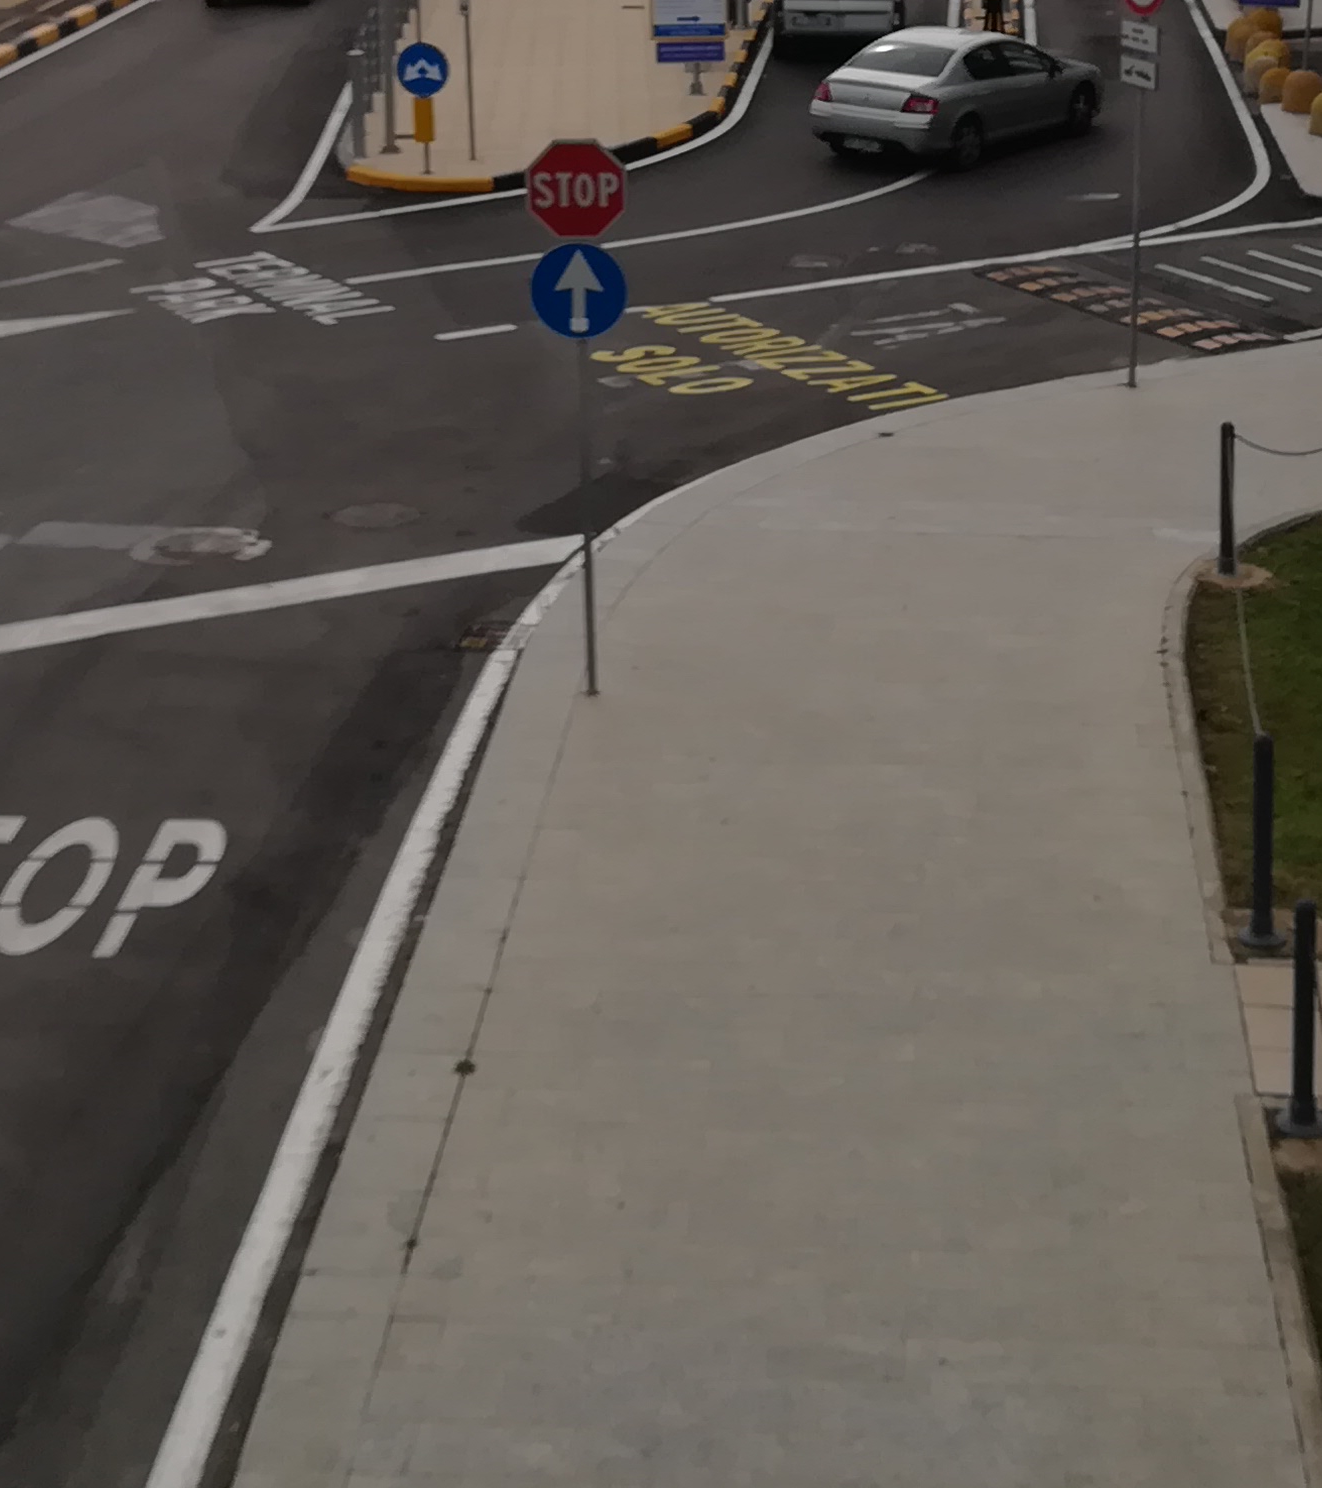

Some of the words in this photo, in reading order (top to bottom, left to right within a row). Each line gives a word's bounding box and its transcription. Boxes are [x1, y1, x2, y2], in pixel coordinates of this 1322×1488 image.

[533, 172, 620, 209] STOP
[129, 276, 277, 324] PARK
[194, 251, 396, 325] TERMINAL
[590, 344, 754, 395] SOLO
[640, 302, 949, 410] AUTORIZZATI
